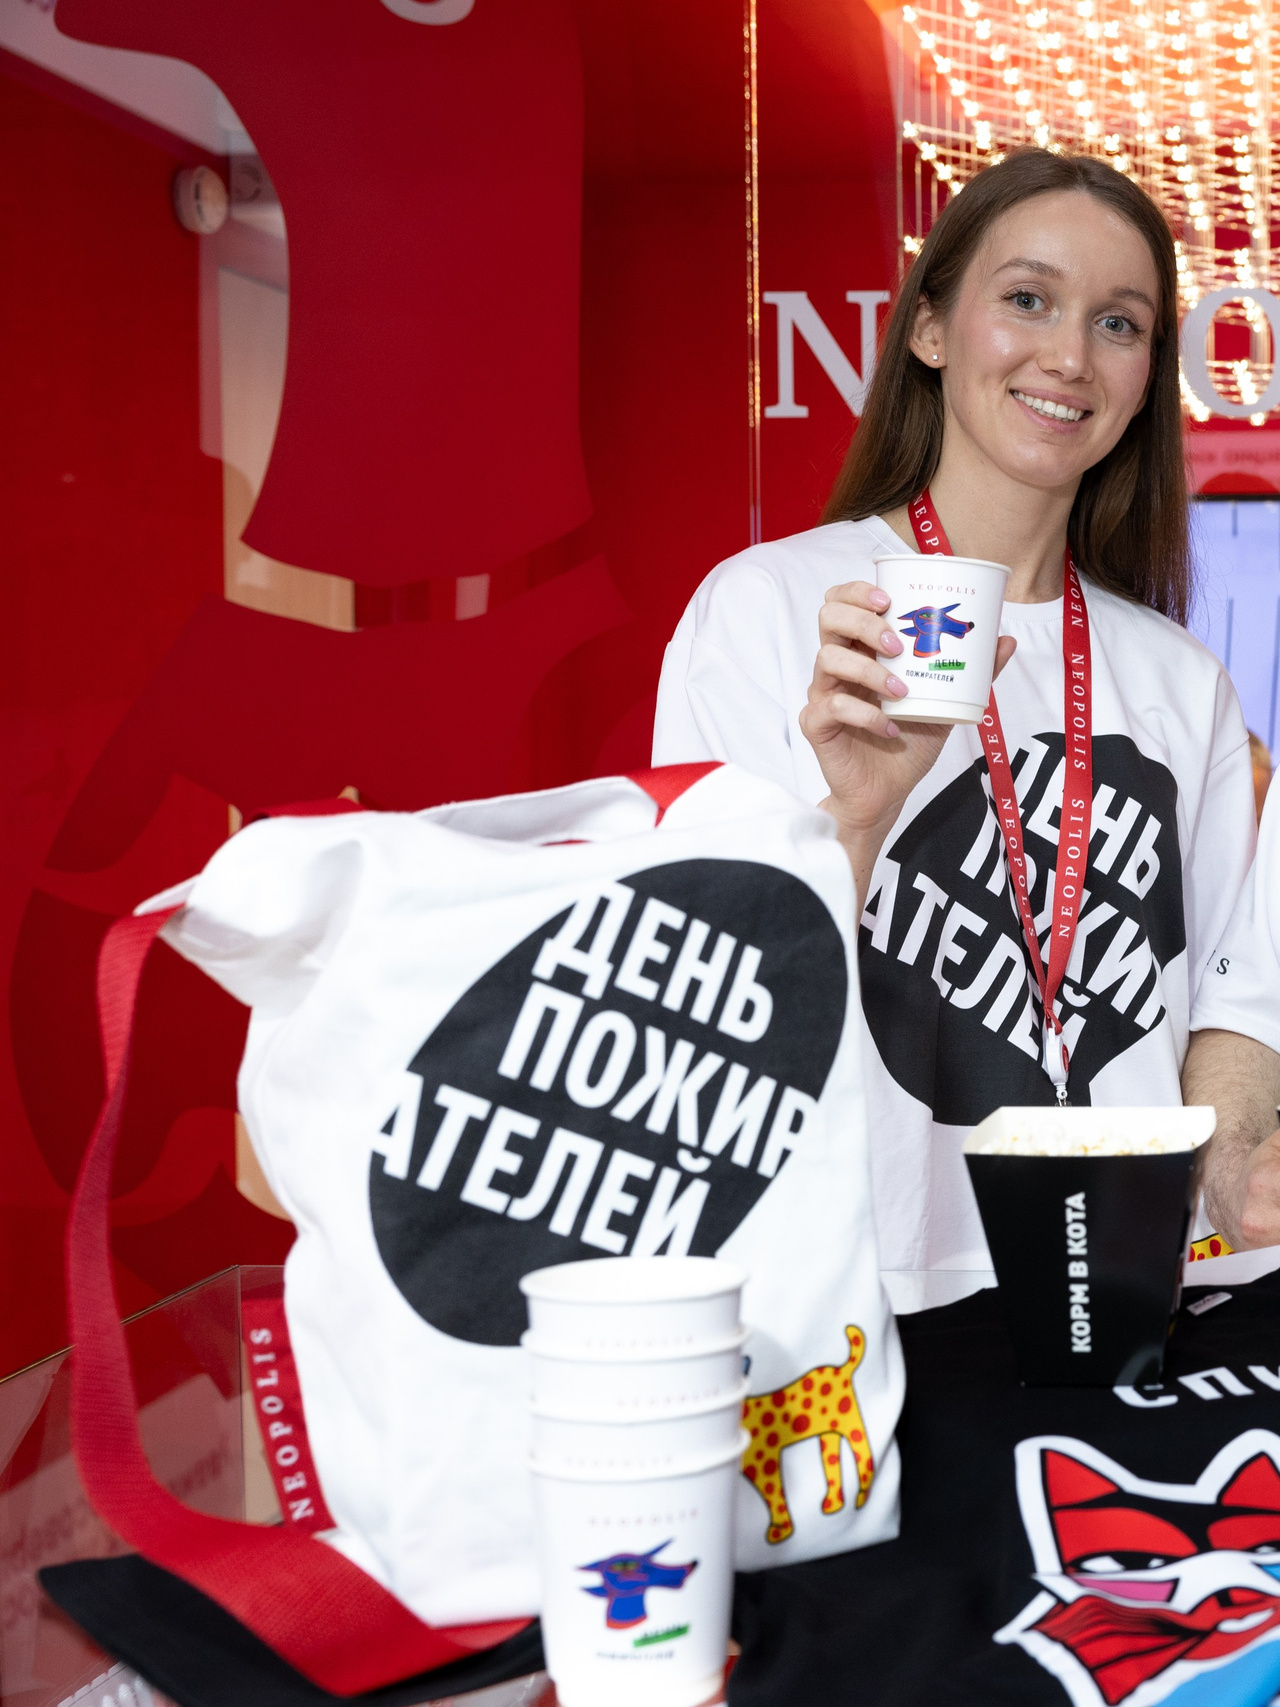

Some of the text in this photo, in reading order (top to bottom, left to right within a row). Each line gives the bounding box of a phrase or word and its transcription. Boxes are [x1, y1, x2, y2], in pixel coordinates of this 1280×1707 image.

[908, 583, 978, 596] NEOPOLIS
[905, 669, 955, 683] ПОЖИРАТЕЛЕЙ
[933, 658, 962, 669] ДЕНЬ
[1071, 652, 1086, 770] NEOPOLIS
[982, 713, 1004, 765] NEO
[1001, 797, 1036, 937] NEOPOLIS
[1059, 798, 1085, 938] NEOPOLIS
[532, 880, 774, 1043] ДЕНЬ
[371, 1070, 712, 1257] АТЕЛЕЙ
[1064, 1191, 1092, 1353] КОРМ В КОТА
[249, 1327, 315, 1522] NEOPOLIS
